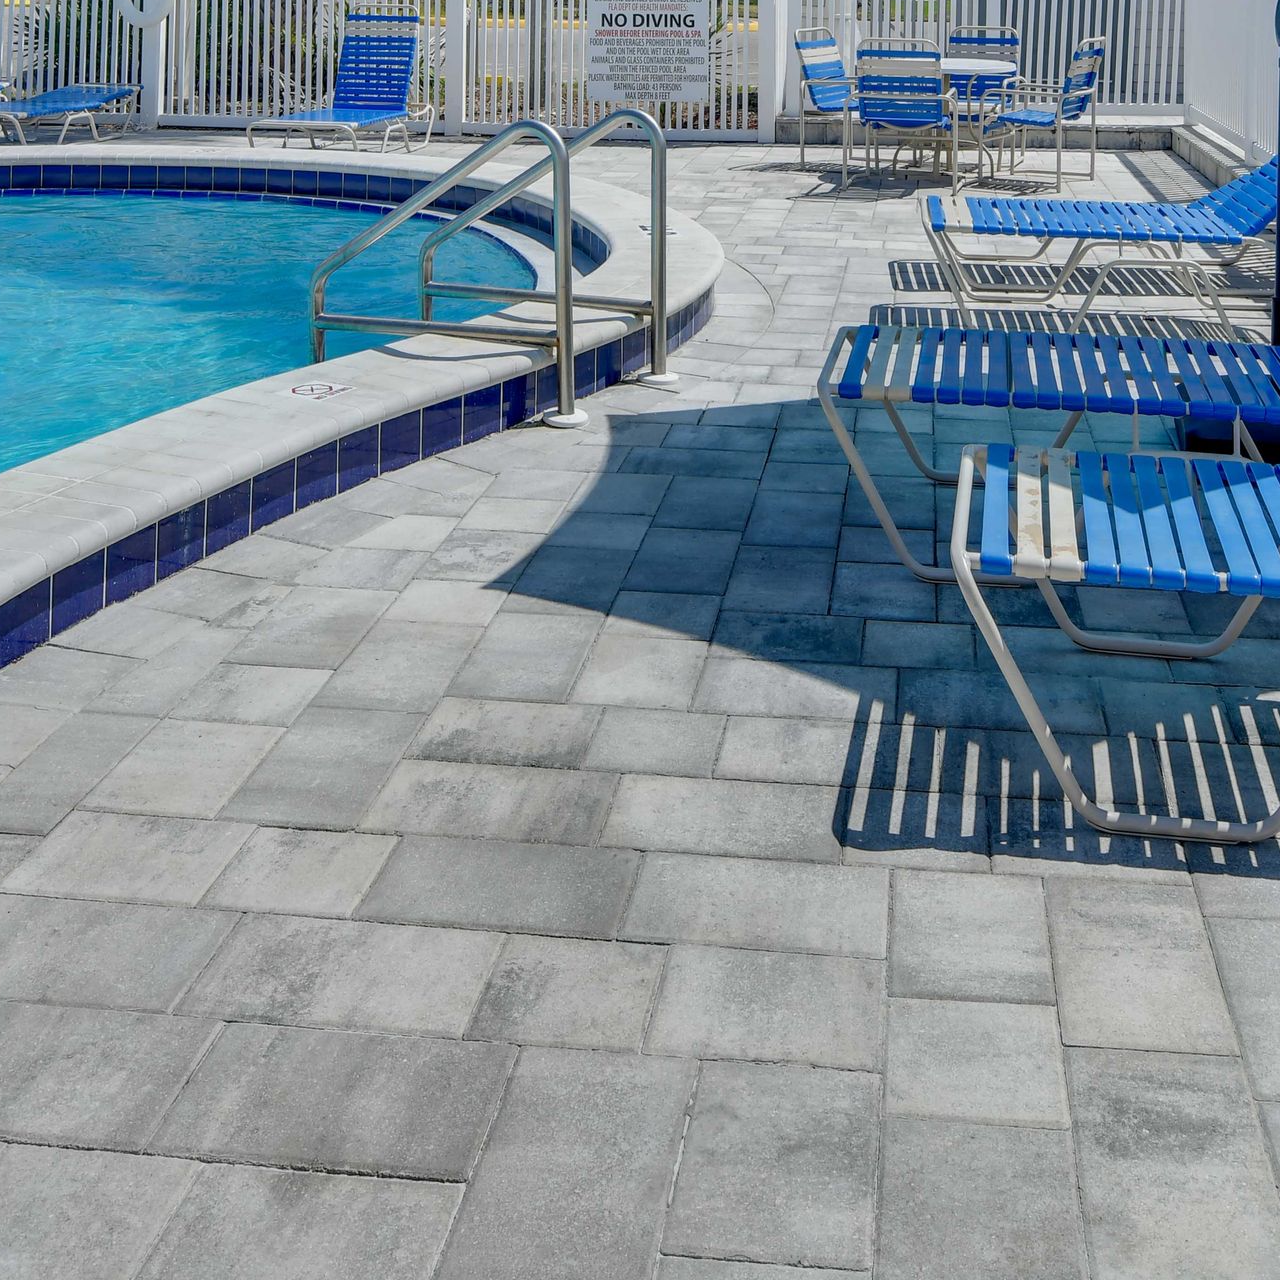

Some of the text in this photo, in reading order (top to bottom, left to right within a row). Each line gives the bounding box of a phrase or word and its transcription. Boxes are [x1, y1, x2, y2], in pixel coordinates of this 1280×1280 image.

[640, 3, 658, 11] HEALTH
[602, 13, 695, 28] NO DIVING
[595, 29, 618, 37] SHOWER
[642, 30, 668, 38] ENTERING
[670, 30, 684, 38] POOL
[604, 38, 615, 46] AND
[617, 38, 645, 46] BEVERAGES
[693, 39, 706, 47] POOL
[606, 47, 617, 55] AND
[615, 56, 625, 64] AND
[629, 65, 638, 73] THE
[639, 65, 657, 73] FENCED
[659, 65, 671, 73] POOL
[684, 75, 707, 83] HYDRATION
[637, 83, 649, 91] LOAD:
[652, 83, 658, 91] 43
[659, 83, 682, 91] PERSONS
[638, 92, 653, 100] DEPTH
[655, 92, 658, 100] 8
[659, 92, 670, 100] FEET
